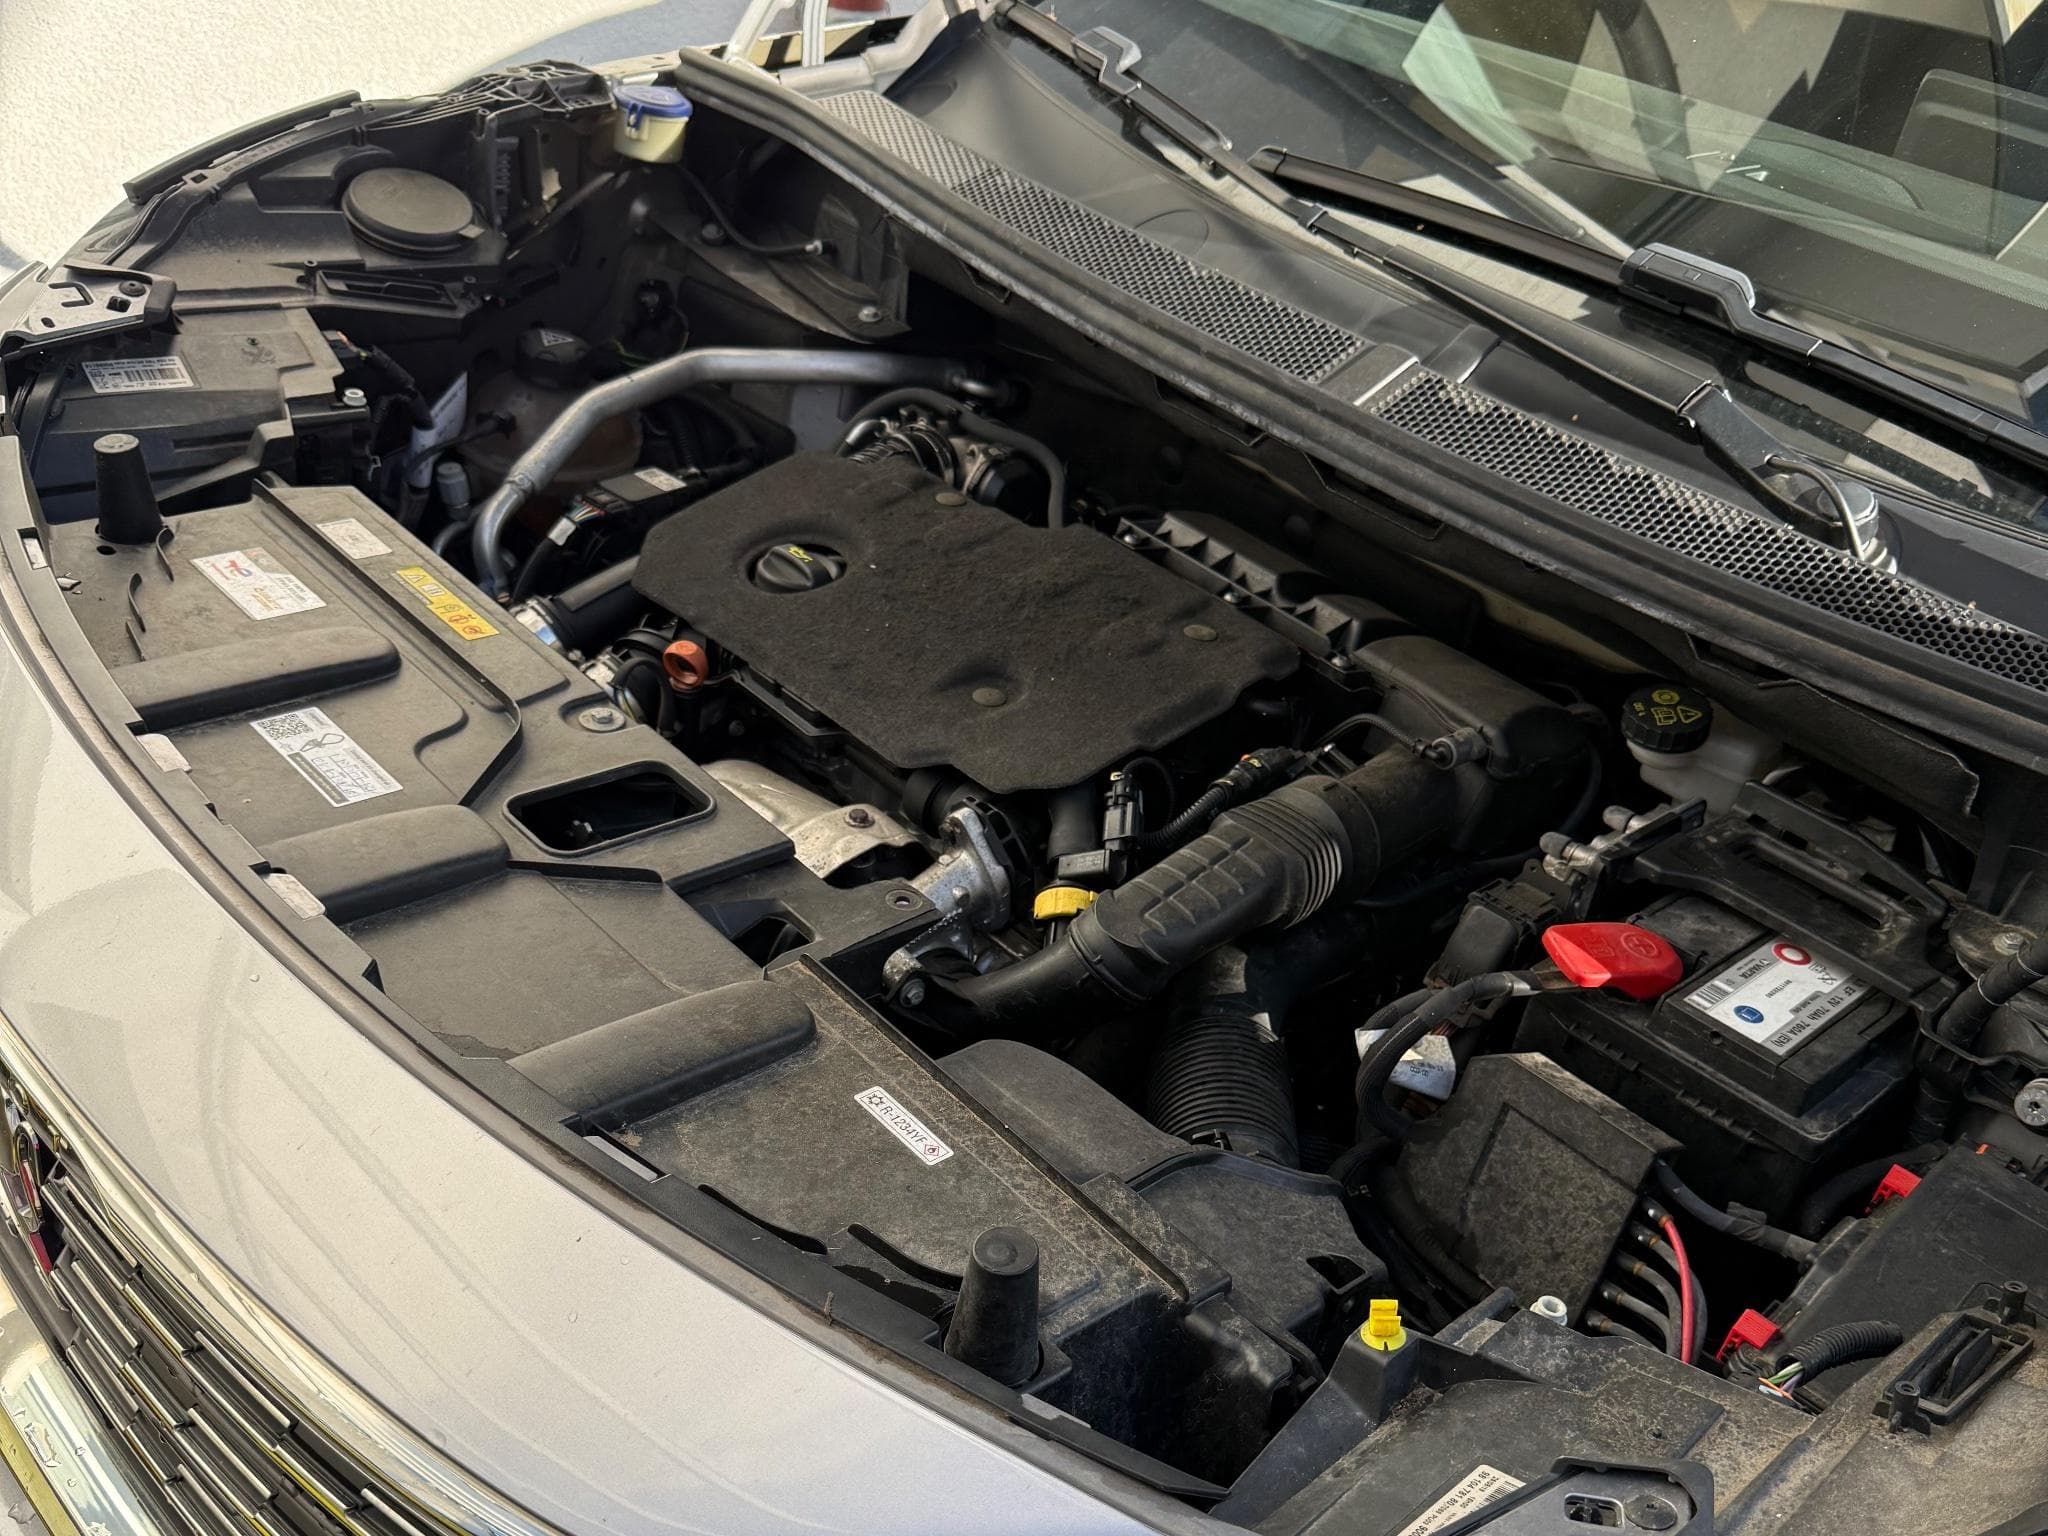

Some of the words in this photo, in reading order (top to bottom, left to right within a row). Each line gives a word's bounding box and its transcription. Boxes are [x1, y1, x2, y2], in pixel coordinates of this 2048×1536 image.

[1827, 995, 1844, 1008] 12V
[1807, 1006, 1830, 1020] 70Ah
[1787, 1020, 1811, 1036] 760A
[880, 1105, 927, 1143] R-1234YF
